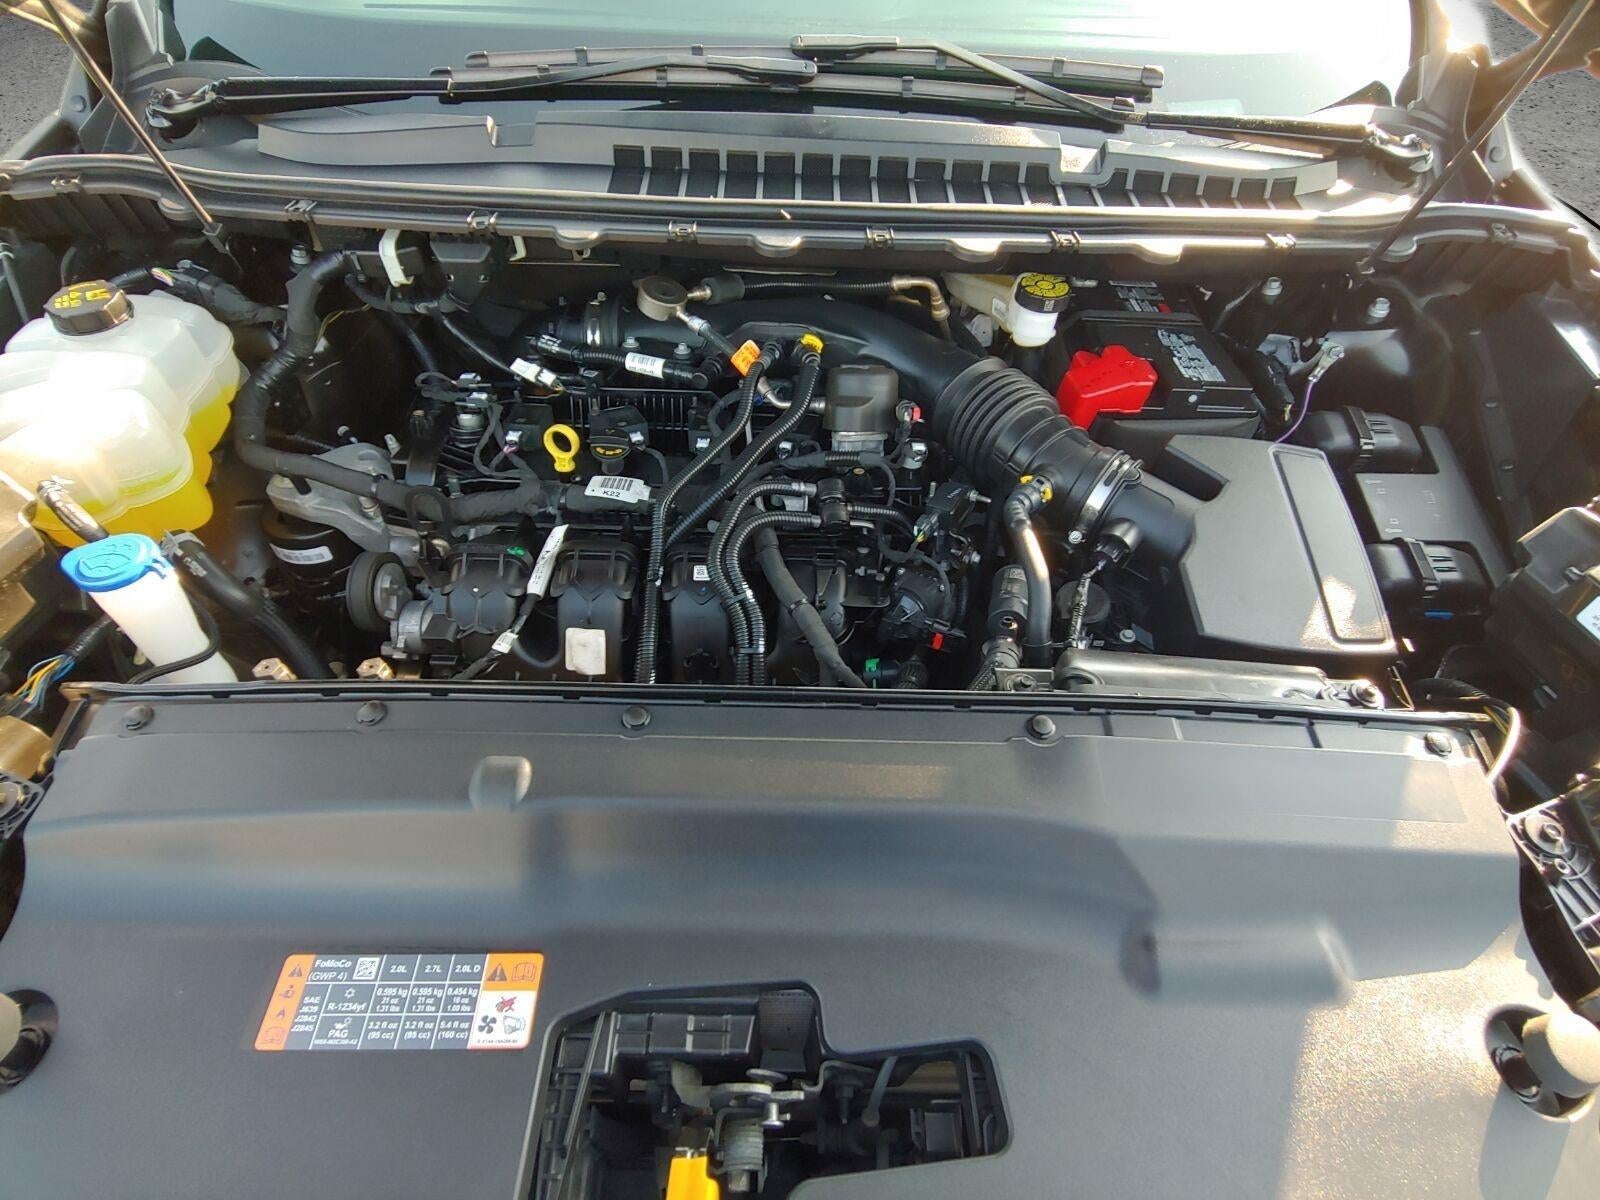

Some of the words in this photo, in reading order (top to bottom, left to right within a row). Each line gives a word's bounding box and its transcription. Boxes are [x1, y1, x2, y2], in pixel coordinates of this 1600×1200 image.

[314, 959, 352, 968] FoMoCo
[390, 964, 408, 973] 2.0L
[424, 964, 442, 973] 2.7L
[454, 964, 472, 973] 2.0L
[474, 964, 481, 973] D
[308, 971, 337, 982] (GWP
[337, 971, 348, 982] 4)
[398, 988, 408, 998] kg
[432, 988, 444, 998] kg
[468, 988, 478, 998] kg
[326, 1002, 367, 1012] R-1234yf
[327, 1029, 348, 1038] PAG
[381, 1031, 394, 1040] cc)
[417, 1031, 431, 1040] cc)
[455, 1031, 469, 1040] cc)
